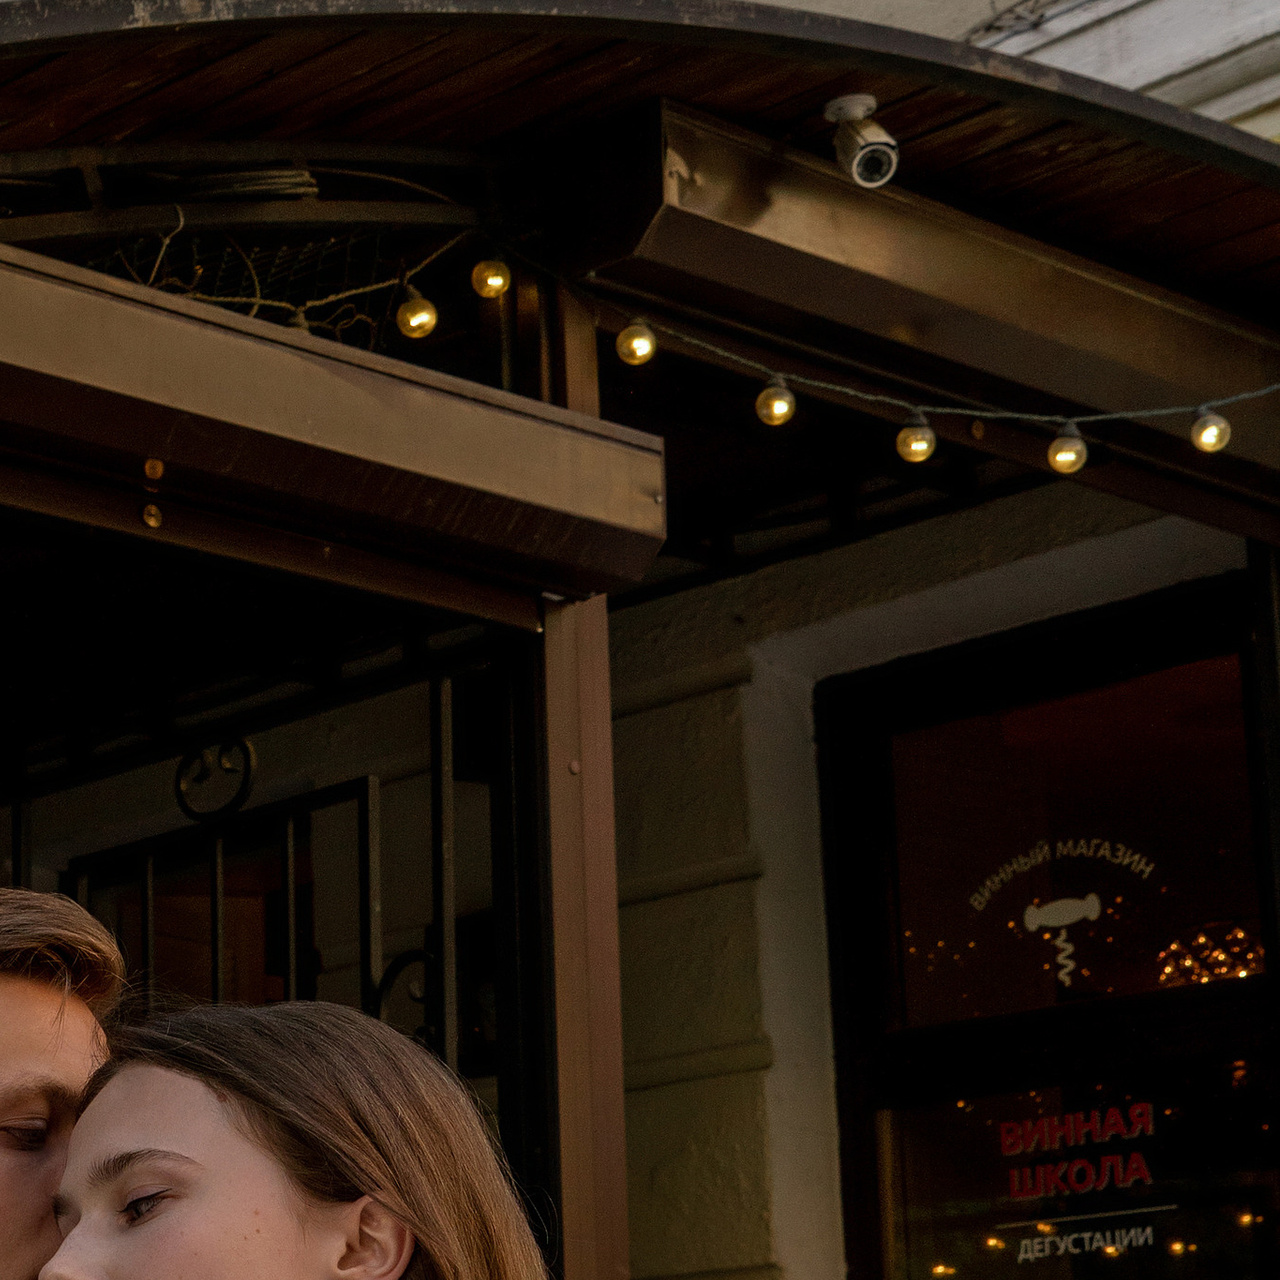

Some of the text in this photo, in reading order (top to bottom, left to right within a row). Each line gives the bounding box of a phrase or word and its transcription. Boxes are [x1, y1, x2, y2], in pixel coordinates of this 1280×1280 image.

[969, 837, 1156, 911] ВИННЫЙ МАГАЗИН
[1000, 1102, 1155, 1157] ВИННАЯ
[1009, 1151, 1153, 1202] ШКОЛА
[1017, 1225, 1154, 1264] ДЕГУСТАЦИИ
